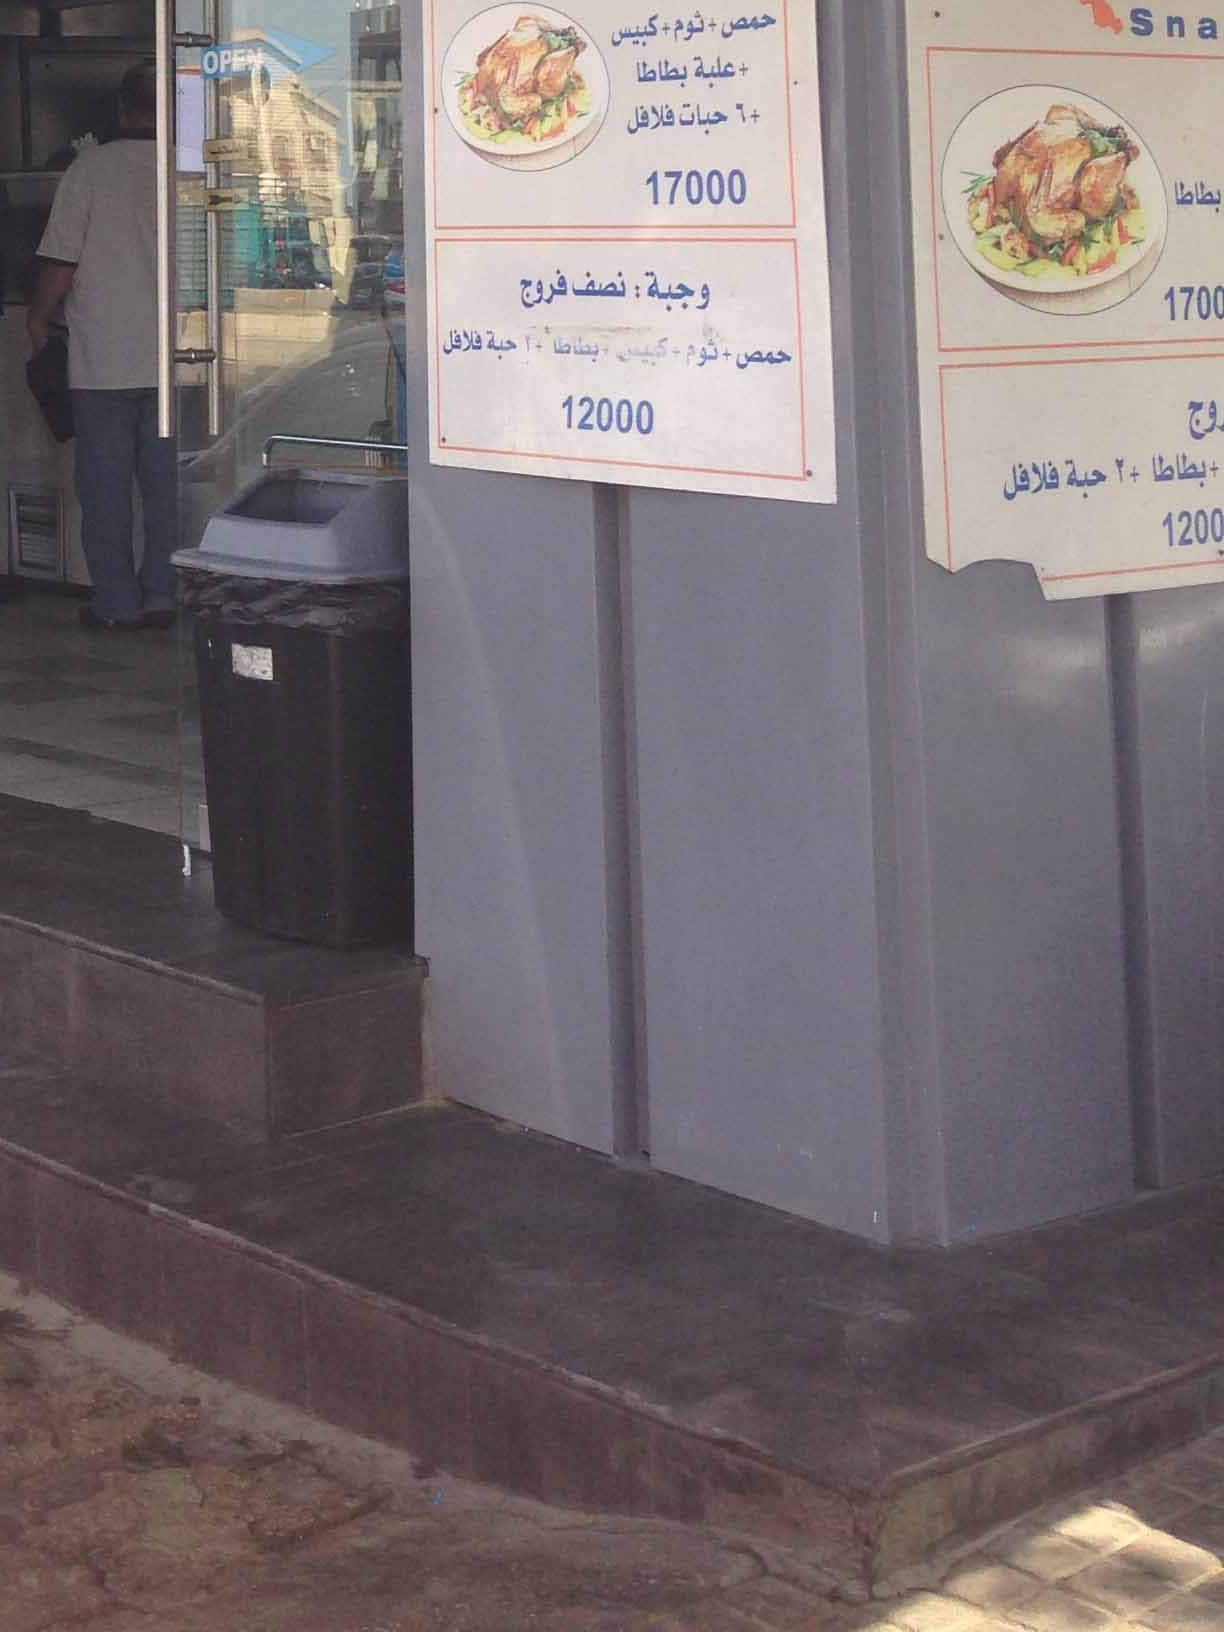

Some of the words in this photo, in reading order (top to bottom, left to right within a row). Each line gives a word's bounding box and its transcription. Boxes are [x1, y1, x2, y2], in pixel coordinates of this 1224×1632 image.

[636, 59, 688, 88] بطاطا
[627, 103, 675, 136] فلافل
[679, 103, 729, 136] حبات
[645, 168, 747, 206] 17000
[519, 268, 568, 309] فروج
[571, 270, 626, 297] نصف
[442, 327, 483, 355] فلافل
[561, 394, 655, 436] 12000
[1003, 460, 1060, 501] فلافل
[1064, 458, 1108, 500] حبة
